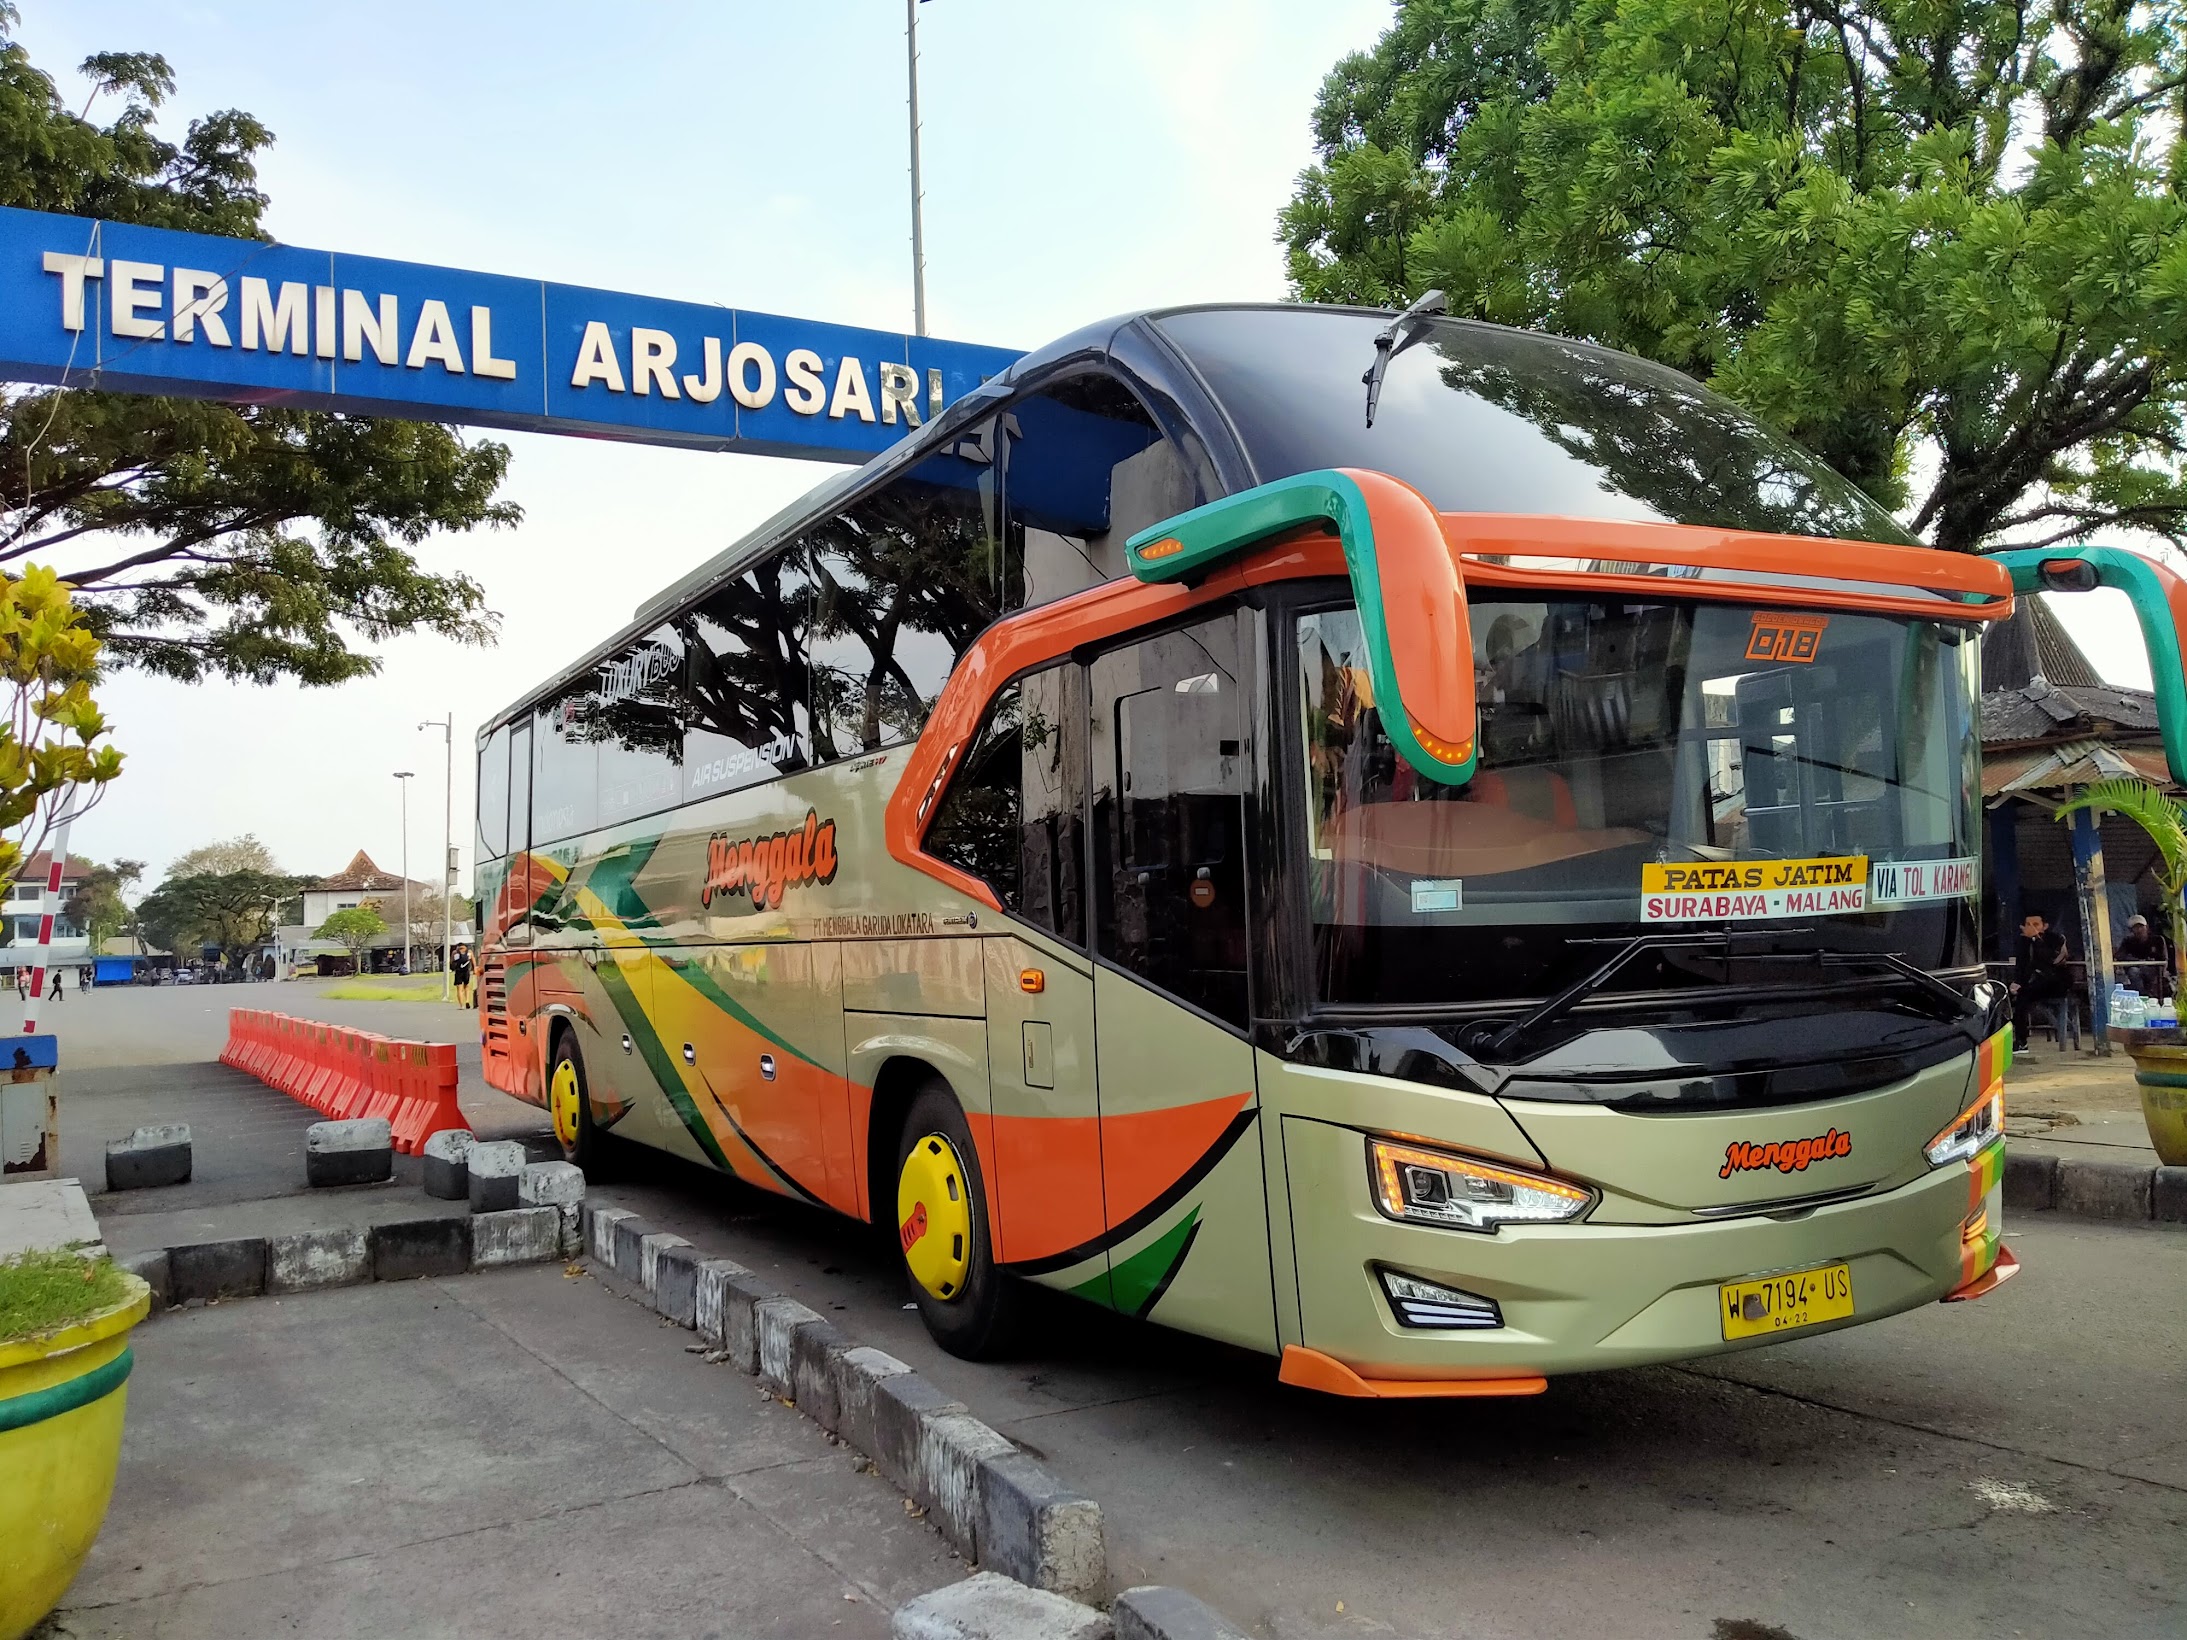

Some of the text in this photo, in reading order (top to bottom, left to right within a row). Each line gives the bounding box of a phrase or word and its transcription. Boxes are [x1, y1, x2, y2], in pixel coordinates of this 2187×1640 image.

[41, 250, 944, 428] TERMINAL ARJOSARI
[702, 806, 838, 911] Menggala
[1664, 863, 1853, 891] PATAS JATIM
[1877, 867, 1897, 898] VIA
[1903, 866, 1926, 897] TOL
[1647, 895, 1768, 919] SURABAYA
[1786, 889, 1862, 913] MALANG
[823, 914, 861, 937] MENGGALA
[862, 914, 892, 936] GARUDA
[1718, 1127, 1852, 1180] Menggala
[1727, 1269, 1849, 1320] W 7194 US
